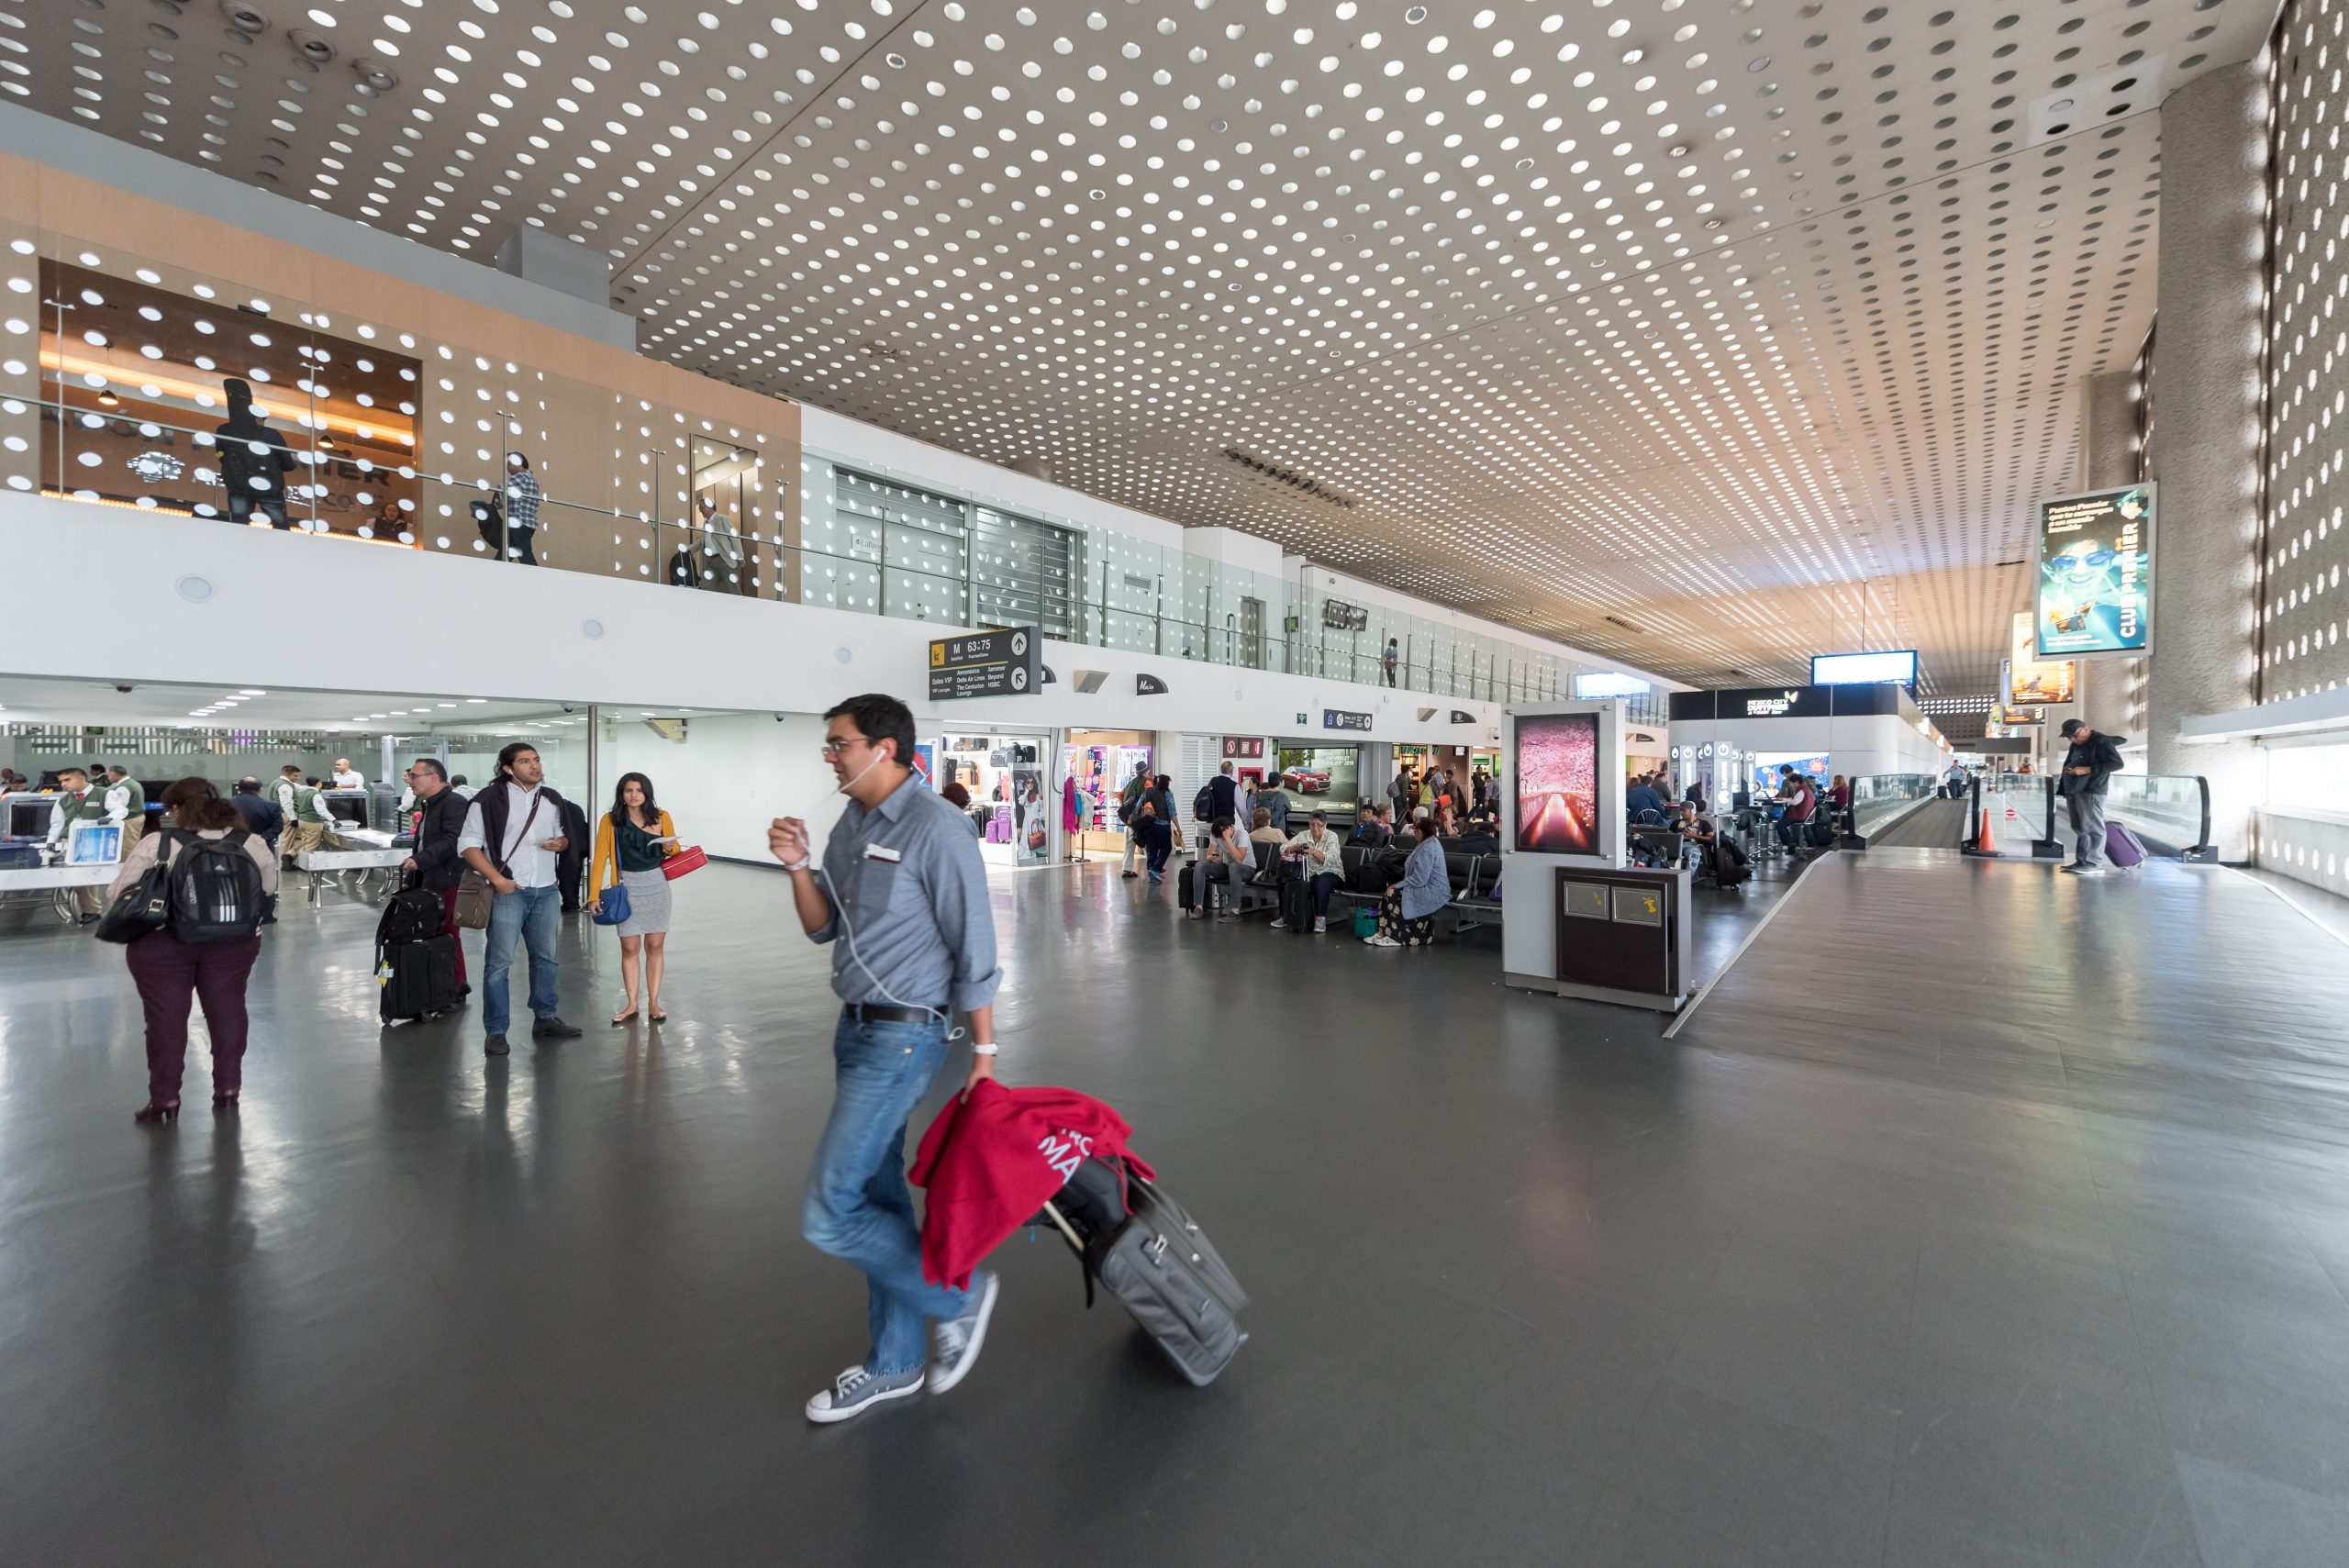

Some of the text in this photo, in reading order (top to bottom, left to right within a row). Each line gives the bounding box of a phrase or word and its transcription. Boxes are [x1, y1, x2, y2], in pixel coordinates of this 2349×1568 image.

[2121, 522, 2139, 638] CLUB PREMIER
[953, 643, 961, 654] M
[967, 641, 976, 652] 63
[982, 639, 991, 650] 75
